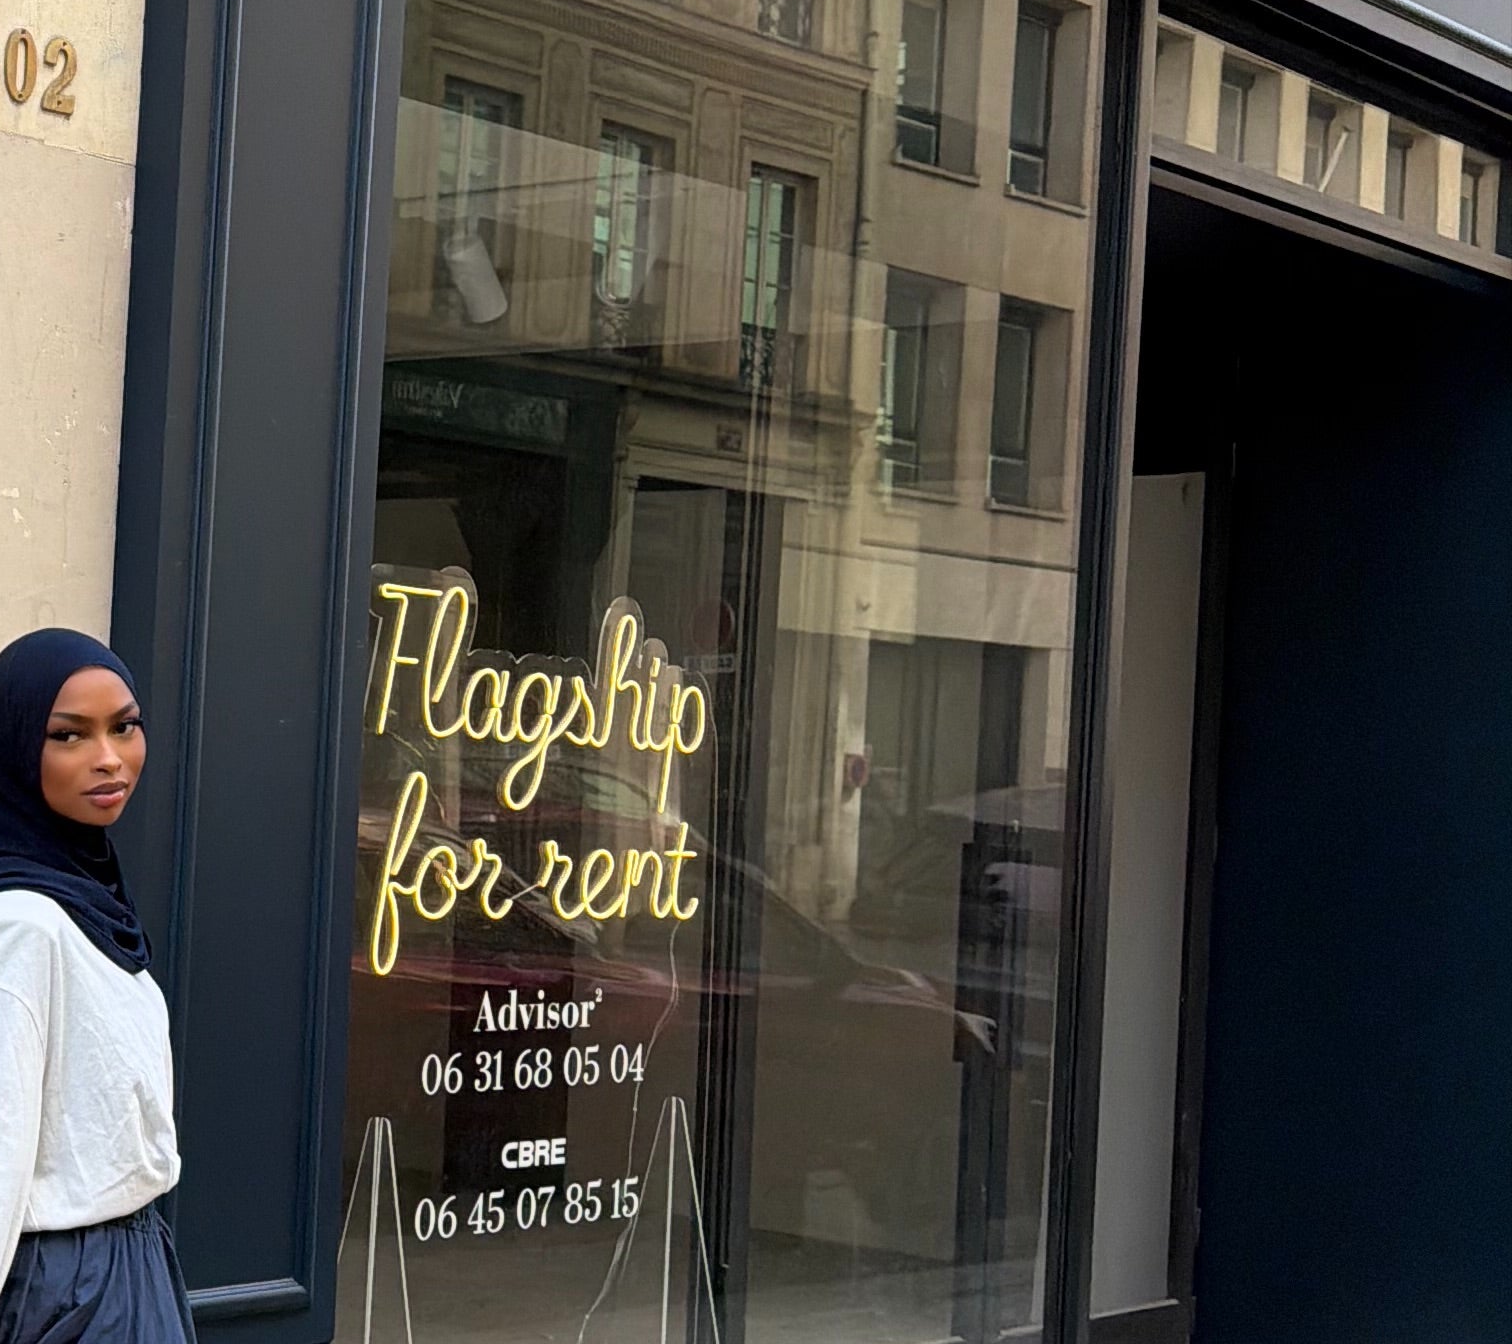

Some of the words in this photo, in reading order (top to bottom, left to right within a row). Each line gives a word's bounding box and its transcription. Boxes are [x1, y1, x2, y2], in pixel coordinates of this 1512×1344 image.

[377, 583, 705, 814] Flagship
[371, 770, 513, 976] for
[537, 821, 699, 920] rent
[421, 1052, 463, 1096] 06
[474, 1050, 505, 1092] 31
[514, 1048, 553, 1090] 68
[563, 1044, 600, 1087] 05
[610, 1043, 645, 1084] 04
[501, 1137, 567, 1169] CBRE
[414, 1195, 458, 1242] 06
[467, 1189, 506, 1235] 45
[516, 1186, 556, 1230] 07
[564, 1179, 603, 1224] 85
[610, 1176, 640, 1219] 15
